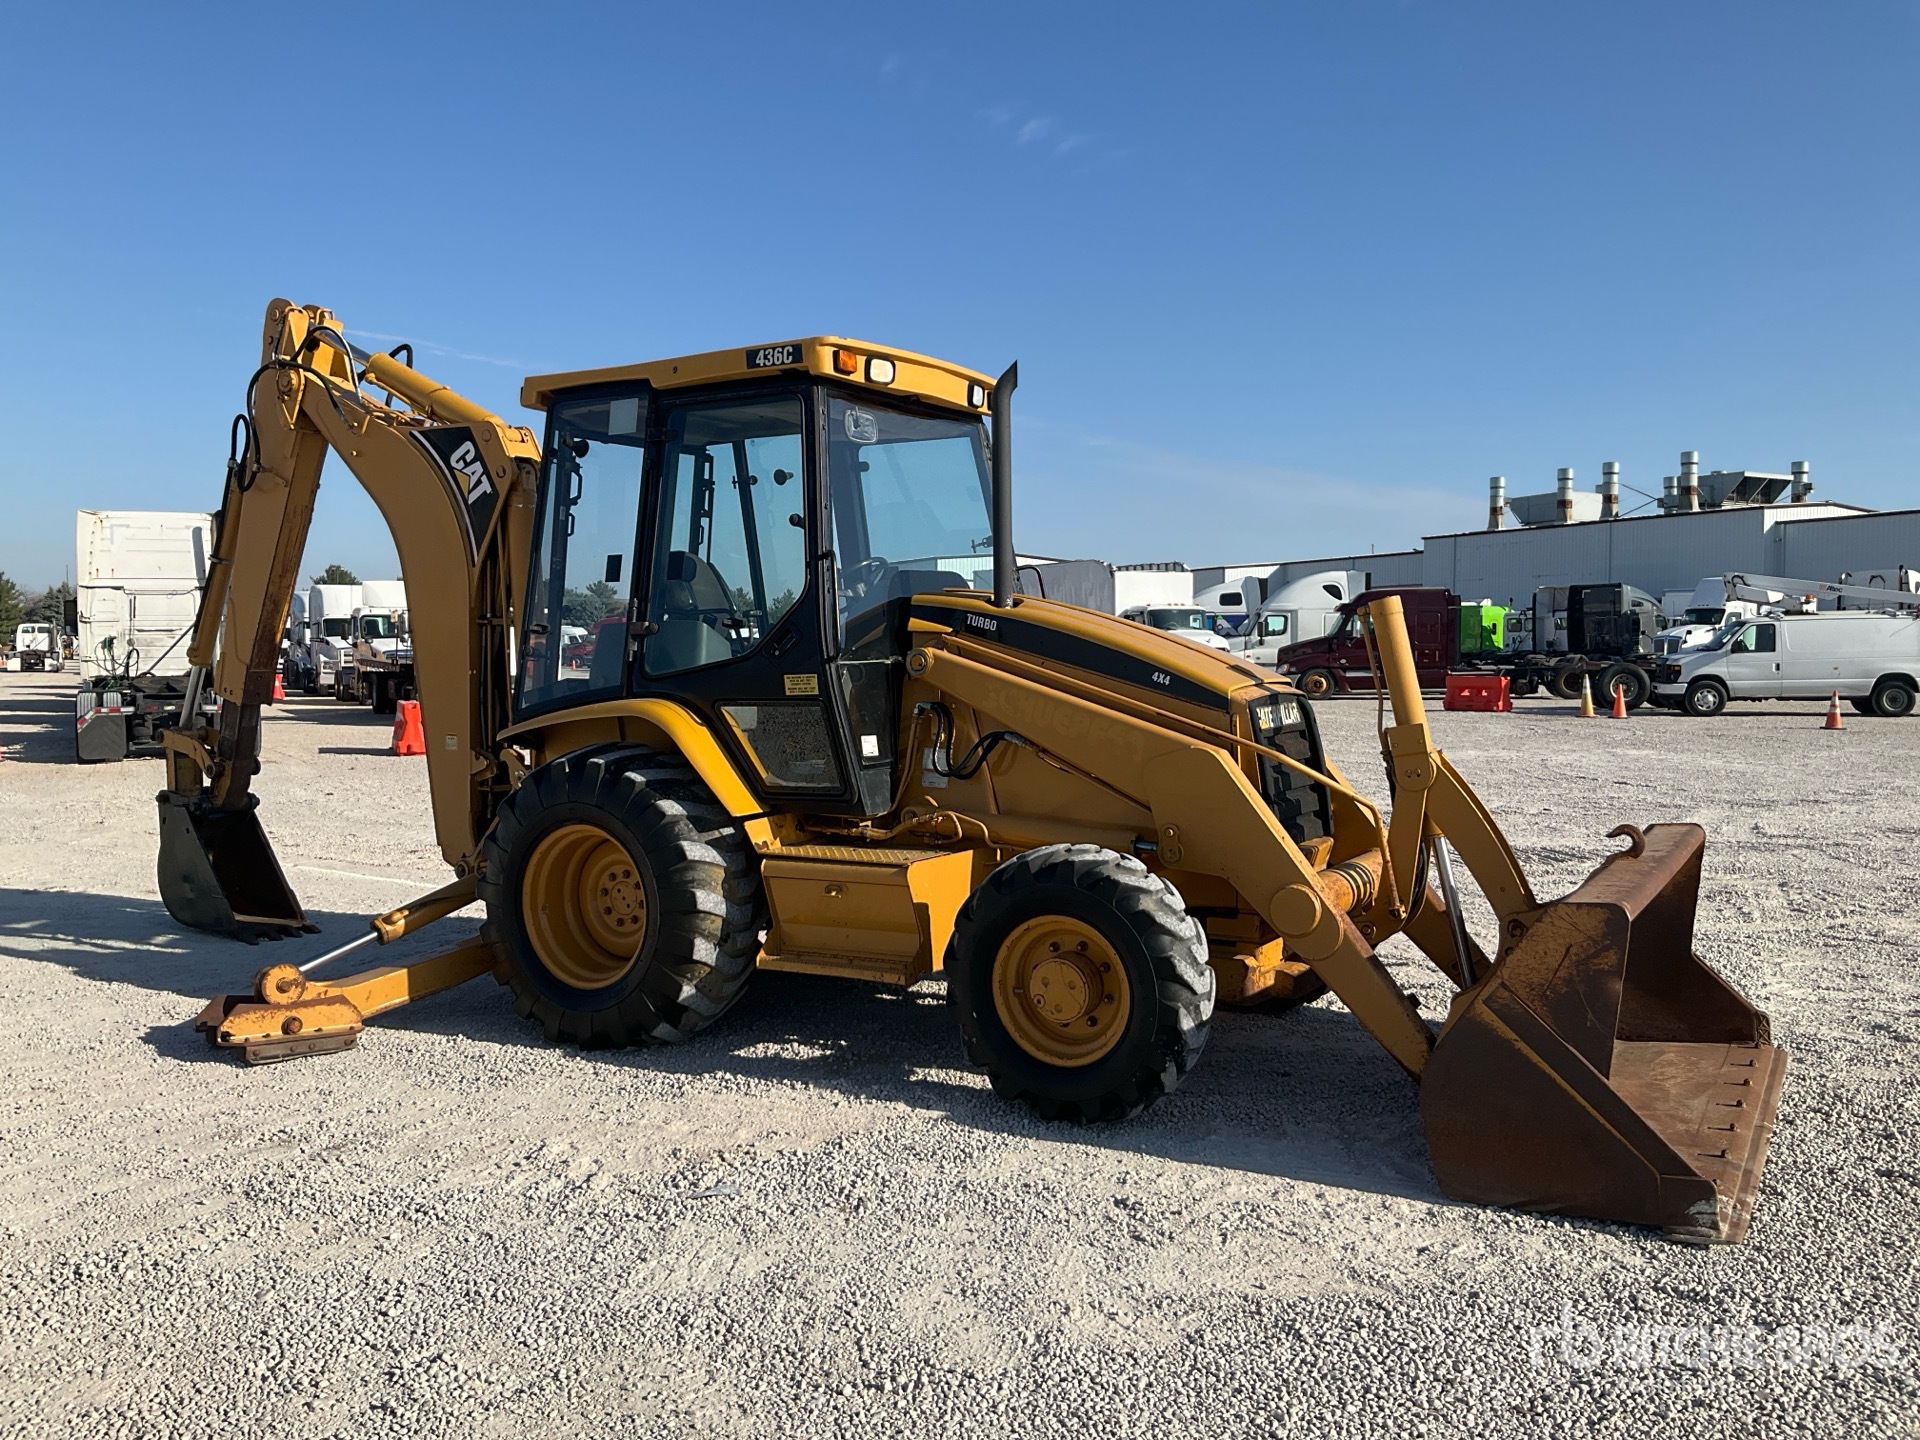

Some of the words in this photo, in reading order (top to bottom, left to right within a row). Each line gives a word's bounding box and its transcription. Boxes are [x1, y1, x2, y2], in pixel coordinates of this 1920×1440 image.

[755, 346, 793, 367] 436C
[450, 440, 492, 505] CAT
[966, 613, 998, 631] TURBO
